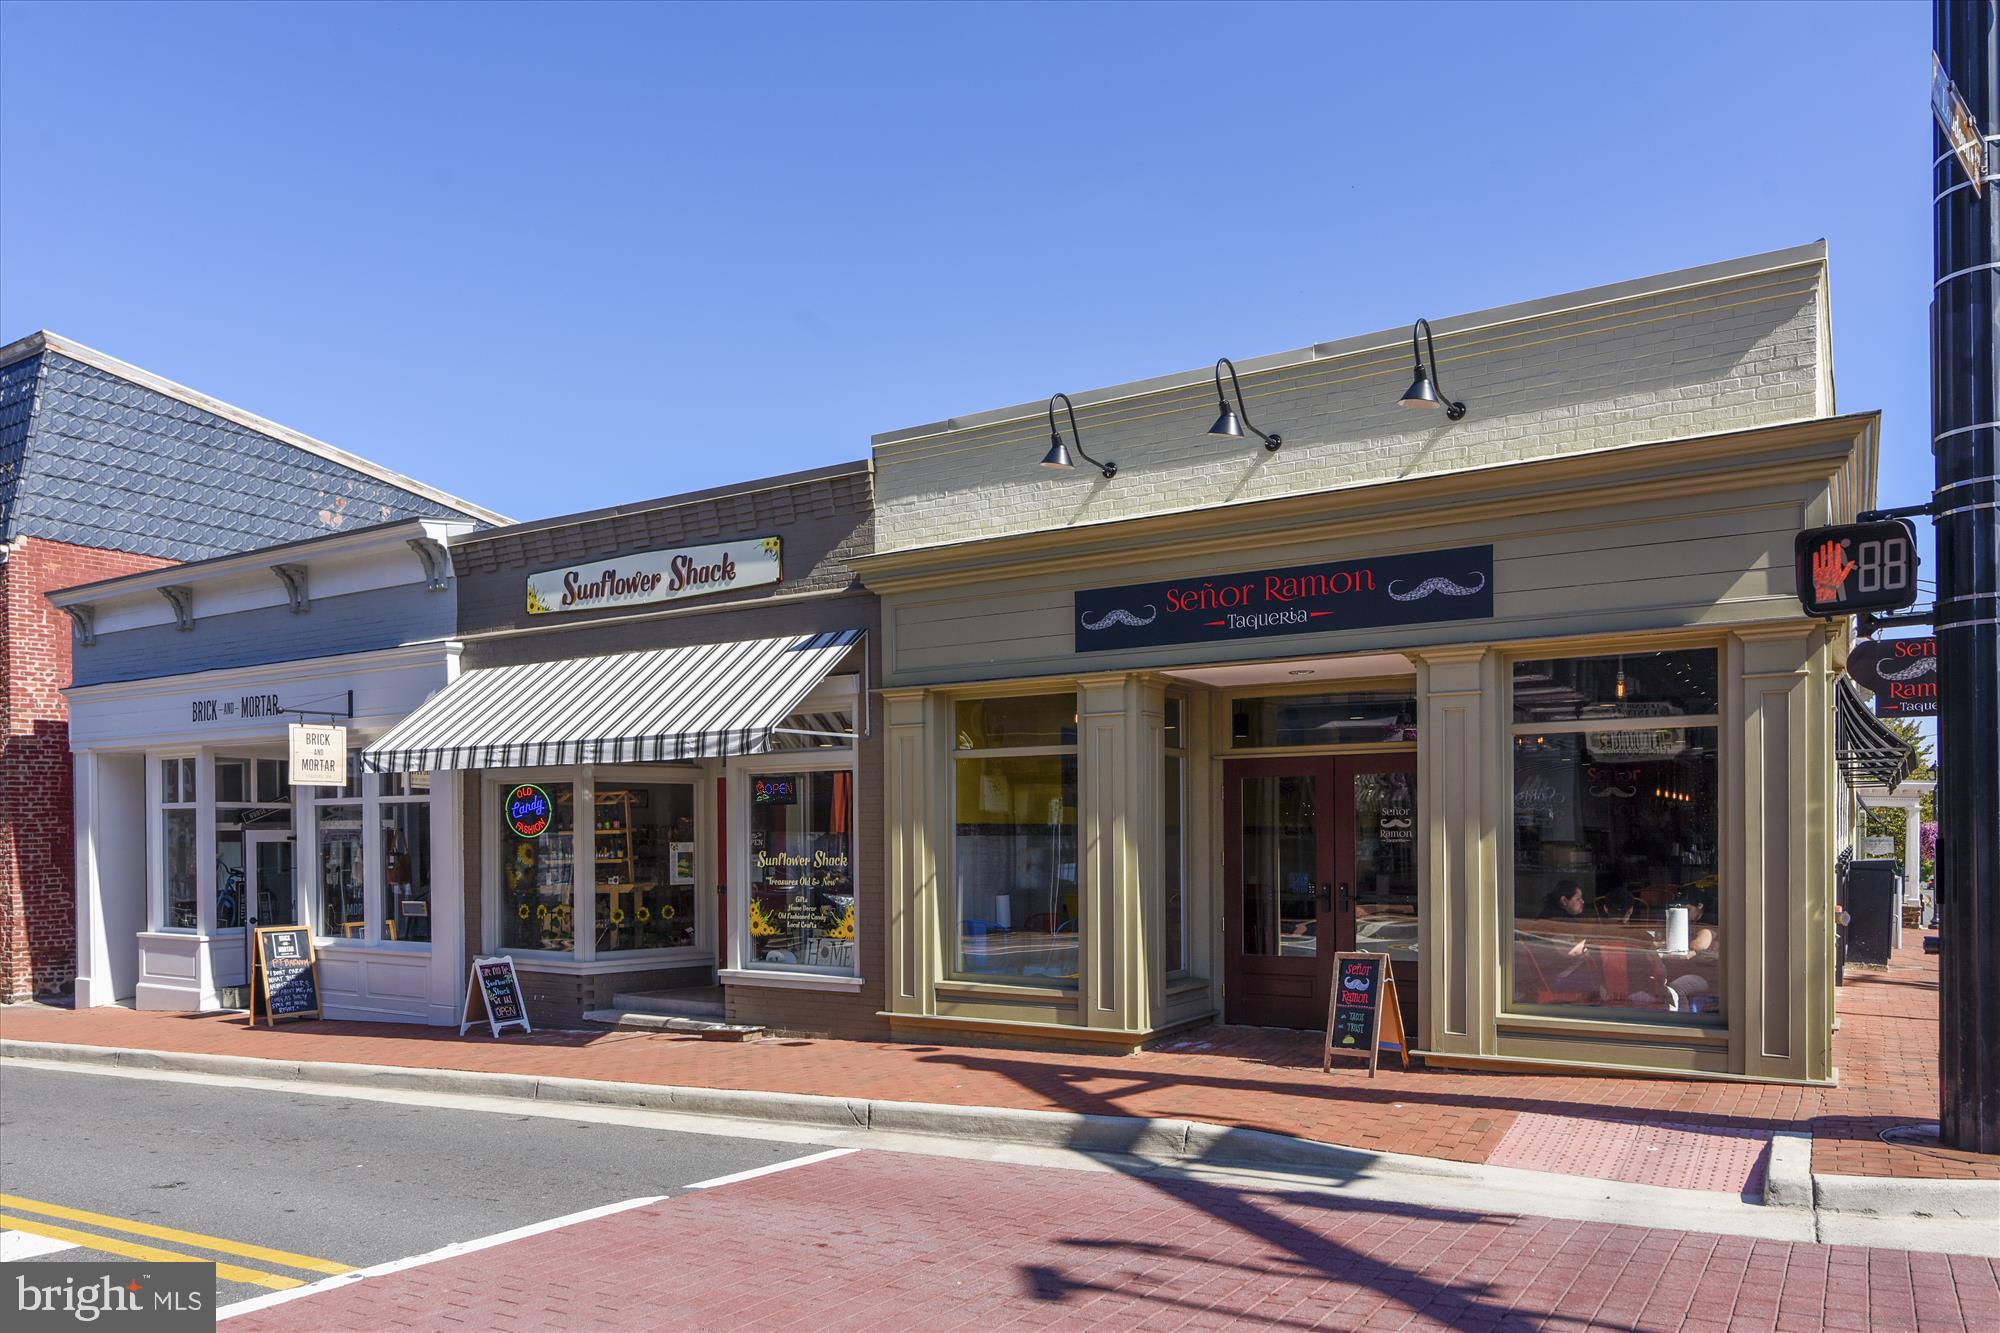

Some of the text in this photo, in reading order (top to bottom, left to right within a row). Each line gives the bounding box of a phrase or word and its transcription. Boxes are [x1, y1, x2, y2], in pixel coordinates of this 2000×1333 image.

[562, 552, 737, 606] Sunflower Shack
[1166, 569, 1377, 613] Señor Ramon
[1895, 638, 1936, 658] Señ
[1890, 682, 1936, 699] Ram
[192, 700, 217, 722] BRICK
[241, 694, 279, 718] MORTAR
[1900, 701, 1937, 712] Taque
[306, 733, 331, 746] BRICK
[301, 758, 335, 772] MORTAR
[516, 787, 533, 799] OLD
[765, 783, 793, 794] OPEN
[511, 795, 545, 819] Candy
[514, 817, 546, 835] FASHION
[1380, 829, 1412, 839] Ramon
[757, 850, 848, 868] Sunflower Shack
[800, 874, 811, 886] Old
[811, 913, 827, 922] Candy
[1342, 990, 1369, 1005] Ramon
